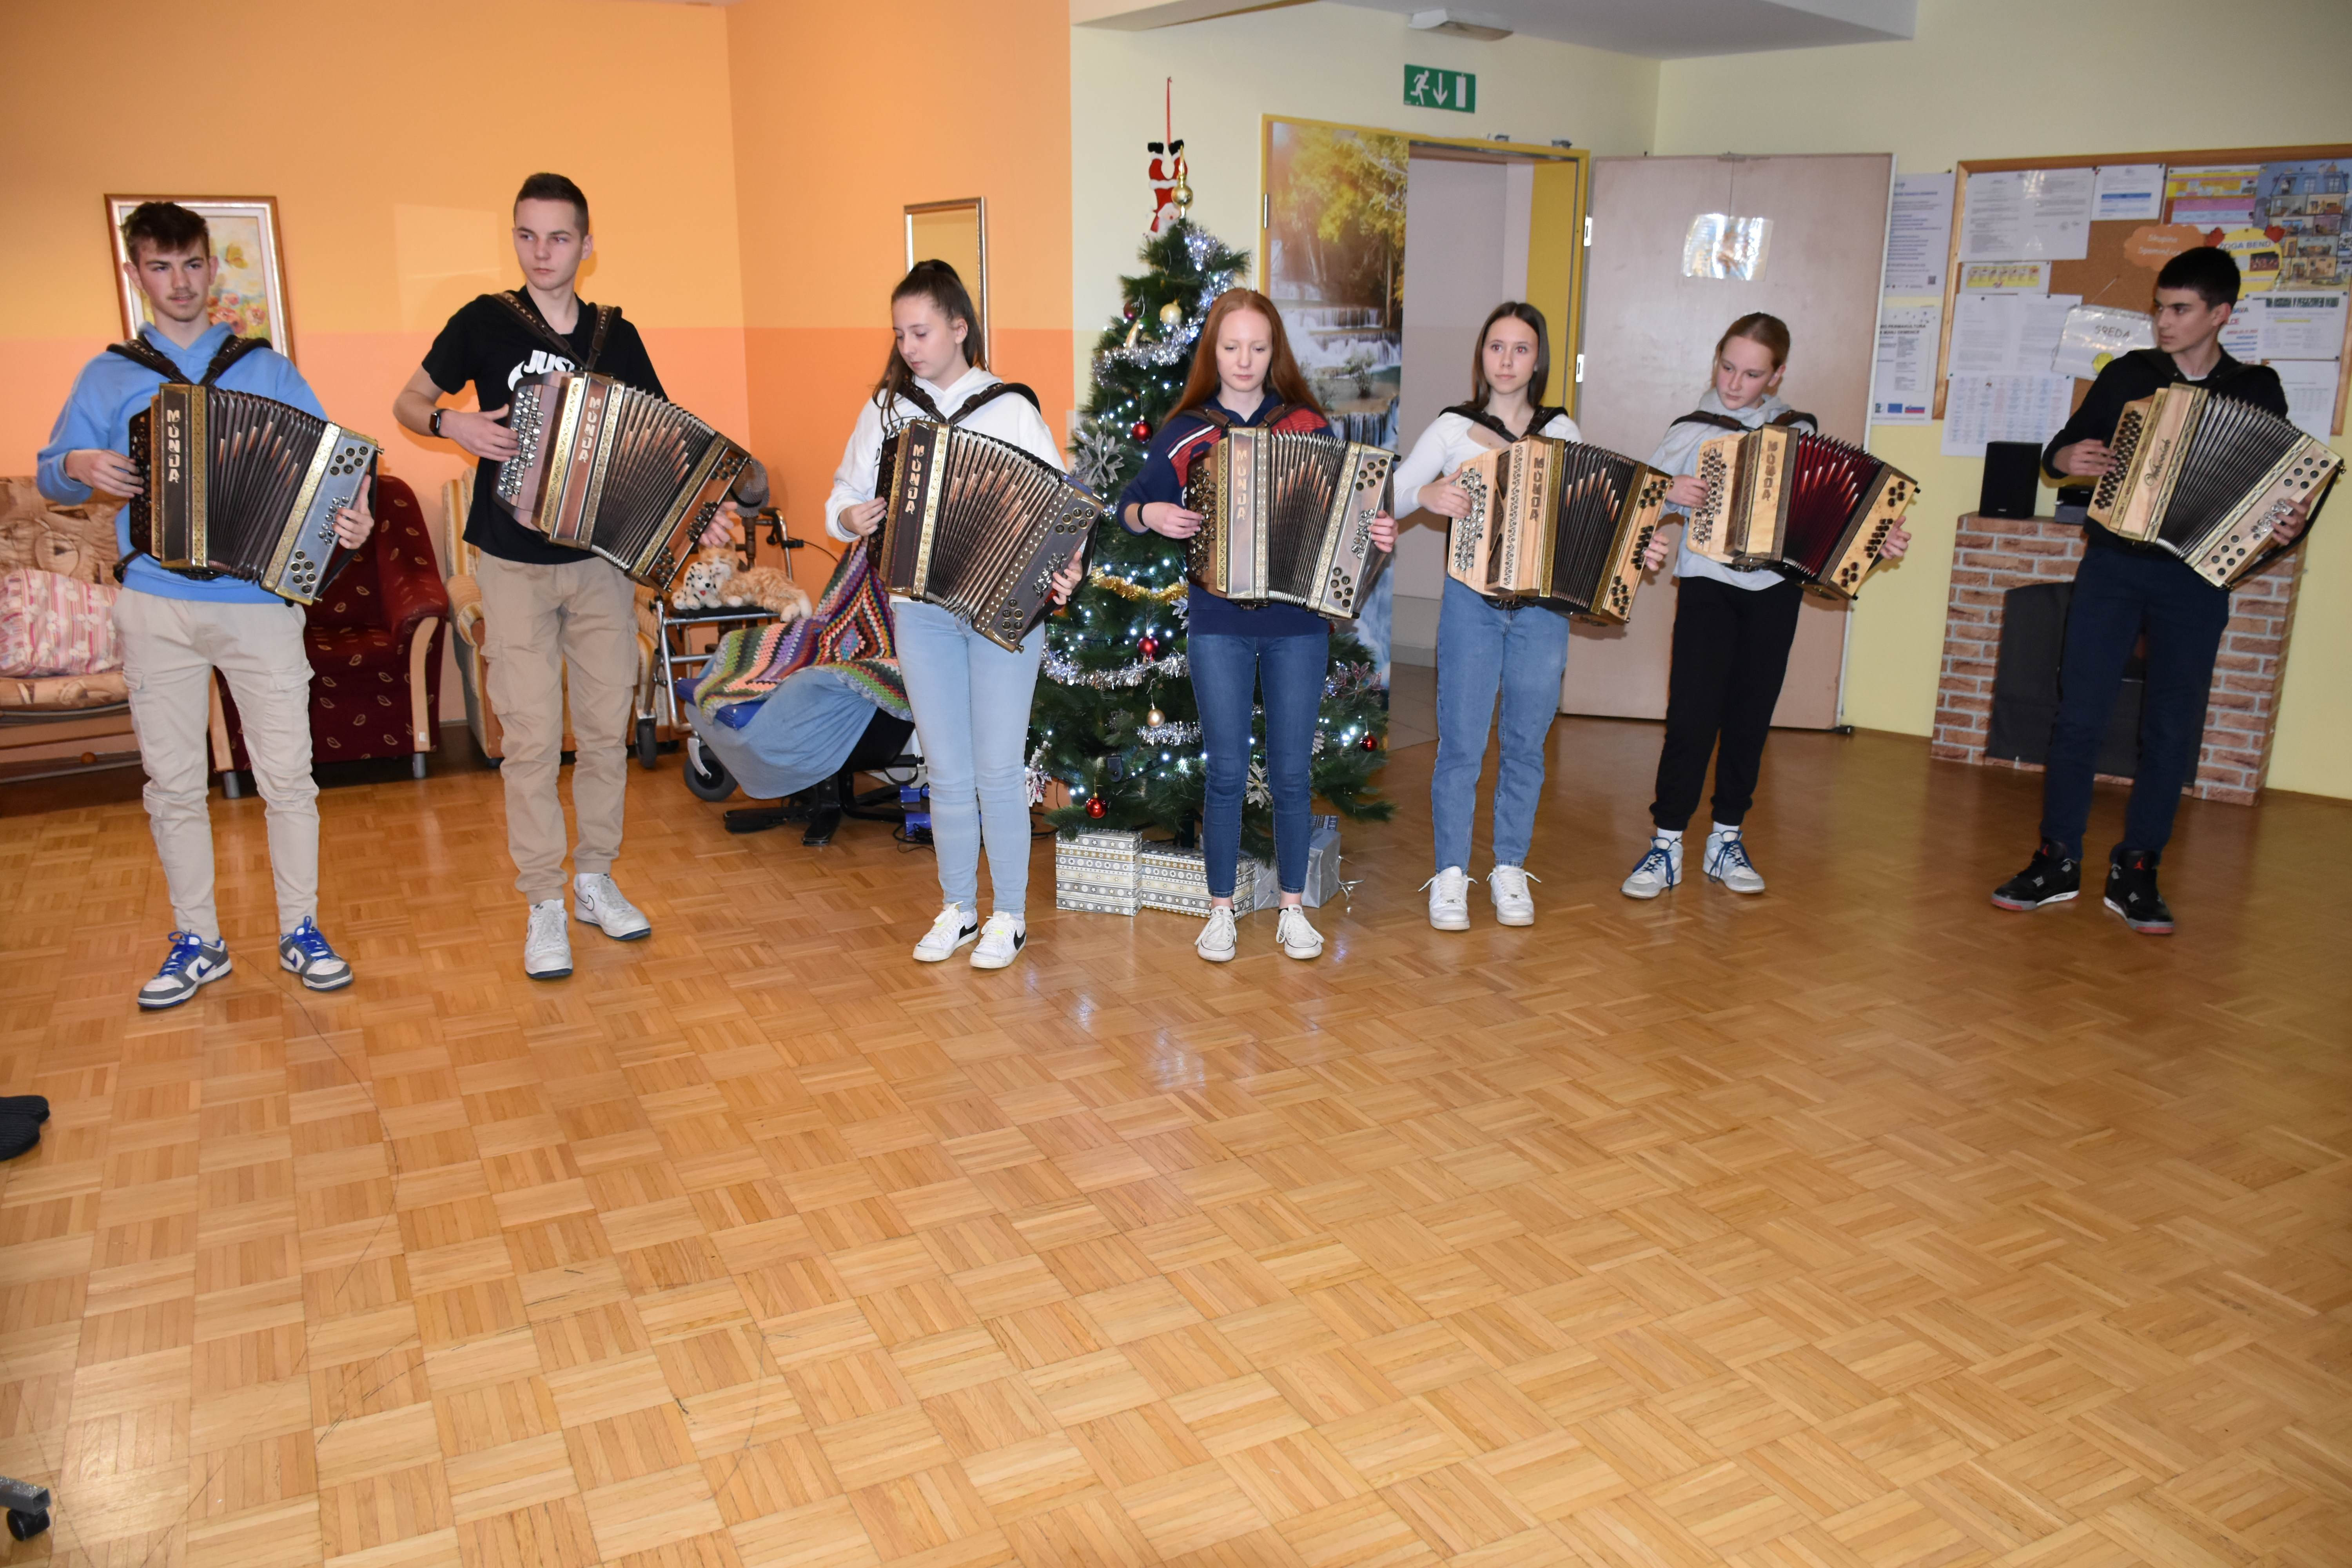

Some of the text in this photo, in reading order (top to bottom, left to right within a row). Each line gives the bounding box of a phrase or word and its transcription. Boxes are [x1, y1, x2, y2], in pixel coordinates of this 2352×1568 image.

[2247, 240, 2271, 248] BEND
[167, 409, 180, 483] MUNDA
[578, 397, 601, 463] MUNDA
[905, 444, 925, 515] MUNDA
[1236, 450, 1247, 520] MUNDA
[1530, 458, 1544, 522] MUNDA
[1762, 441, 1778, 502] MUNDA
